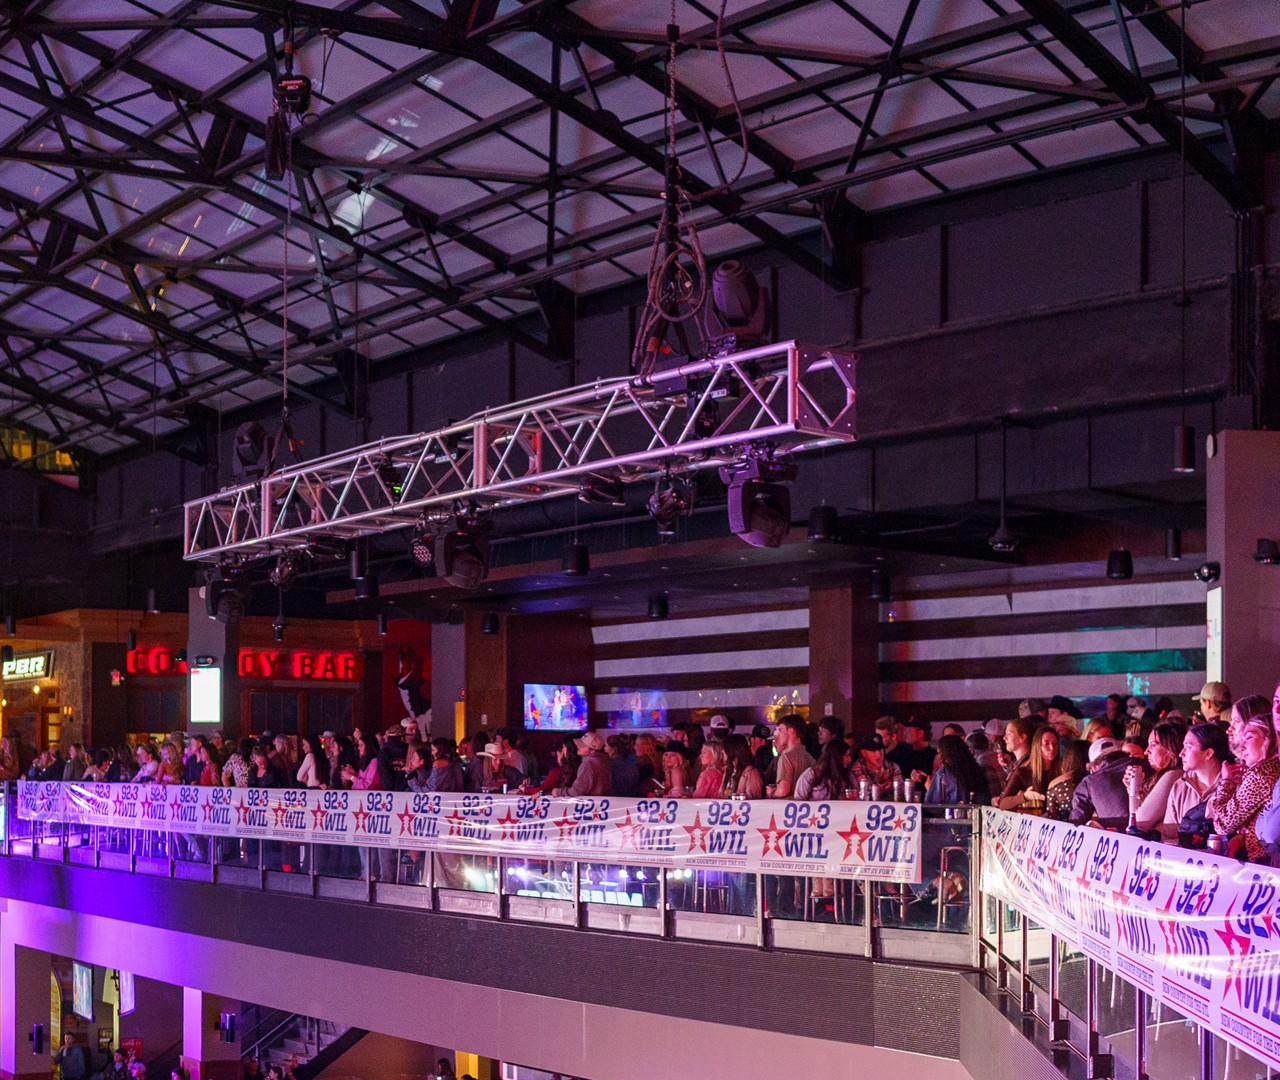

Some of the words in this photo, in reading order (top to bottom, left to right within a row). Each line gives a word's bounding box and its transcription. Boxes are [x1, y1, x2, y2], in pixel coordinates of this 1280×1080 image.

[3, 656, 45, 676] PBR
[300, 652, 358, 678] BAR
[121, 802, 137, 818] WIL
[150, 804, 166, 820] WIL
[180, 805, 197, 822] WIL
[212, 808, 231, 825] WIL
[248, 809, 268, 827] WIL
[285, 811, 306, 829] WIL
[325, 813, 347, 832] WIL
[367, 814, 392, 835] WIL
[413, 816, 439, 837] WIL
[709, 830, 748, 855] WIL
[784, 832, 829, 859] WIL
[868, 835, 915, 864] WIL
